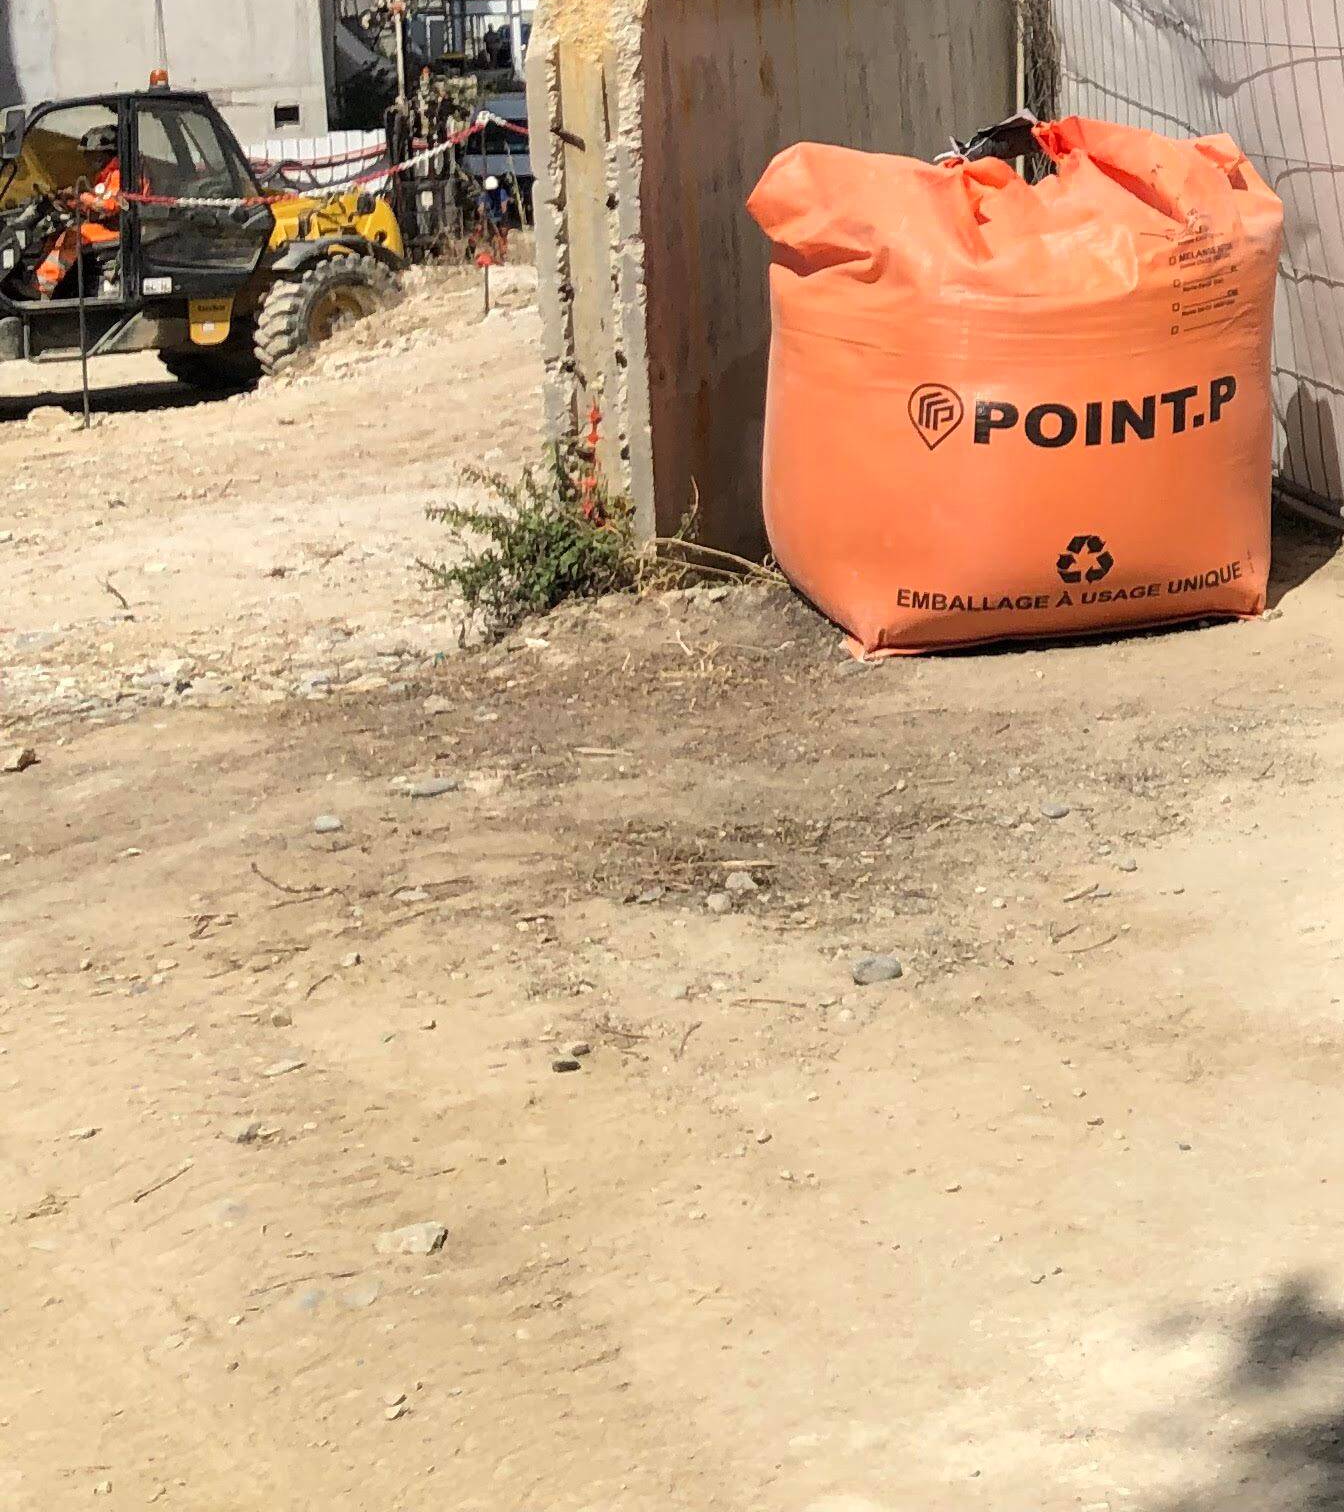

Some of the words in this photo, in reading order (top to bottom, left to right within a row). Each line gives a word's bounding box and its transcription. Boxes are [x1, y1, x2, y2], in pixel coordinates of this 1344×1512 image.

[974, 375, 1237, 448] POINT.P
[896, 588, 1050, 612] EMBALLAGE
[1056, 590, 1074, 608] À
[1081, 582, 1162, 605] USAGE
[1168, 561, 1242, 594] UNIQUE
